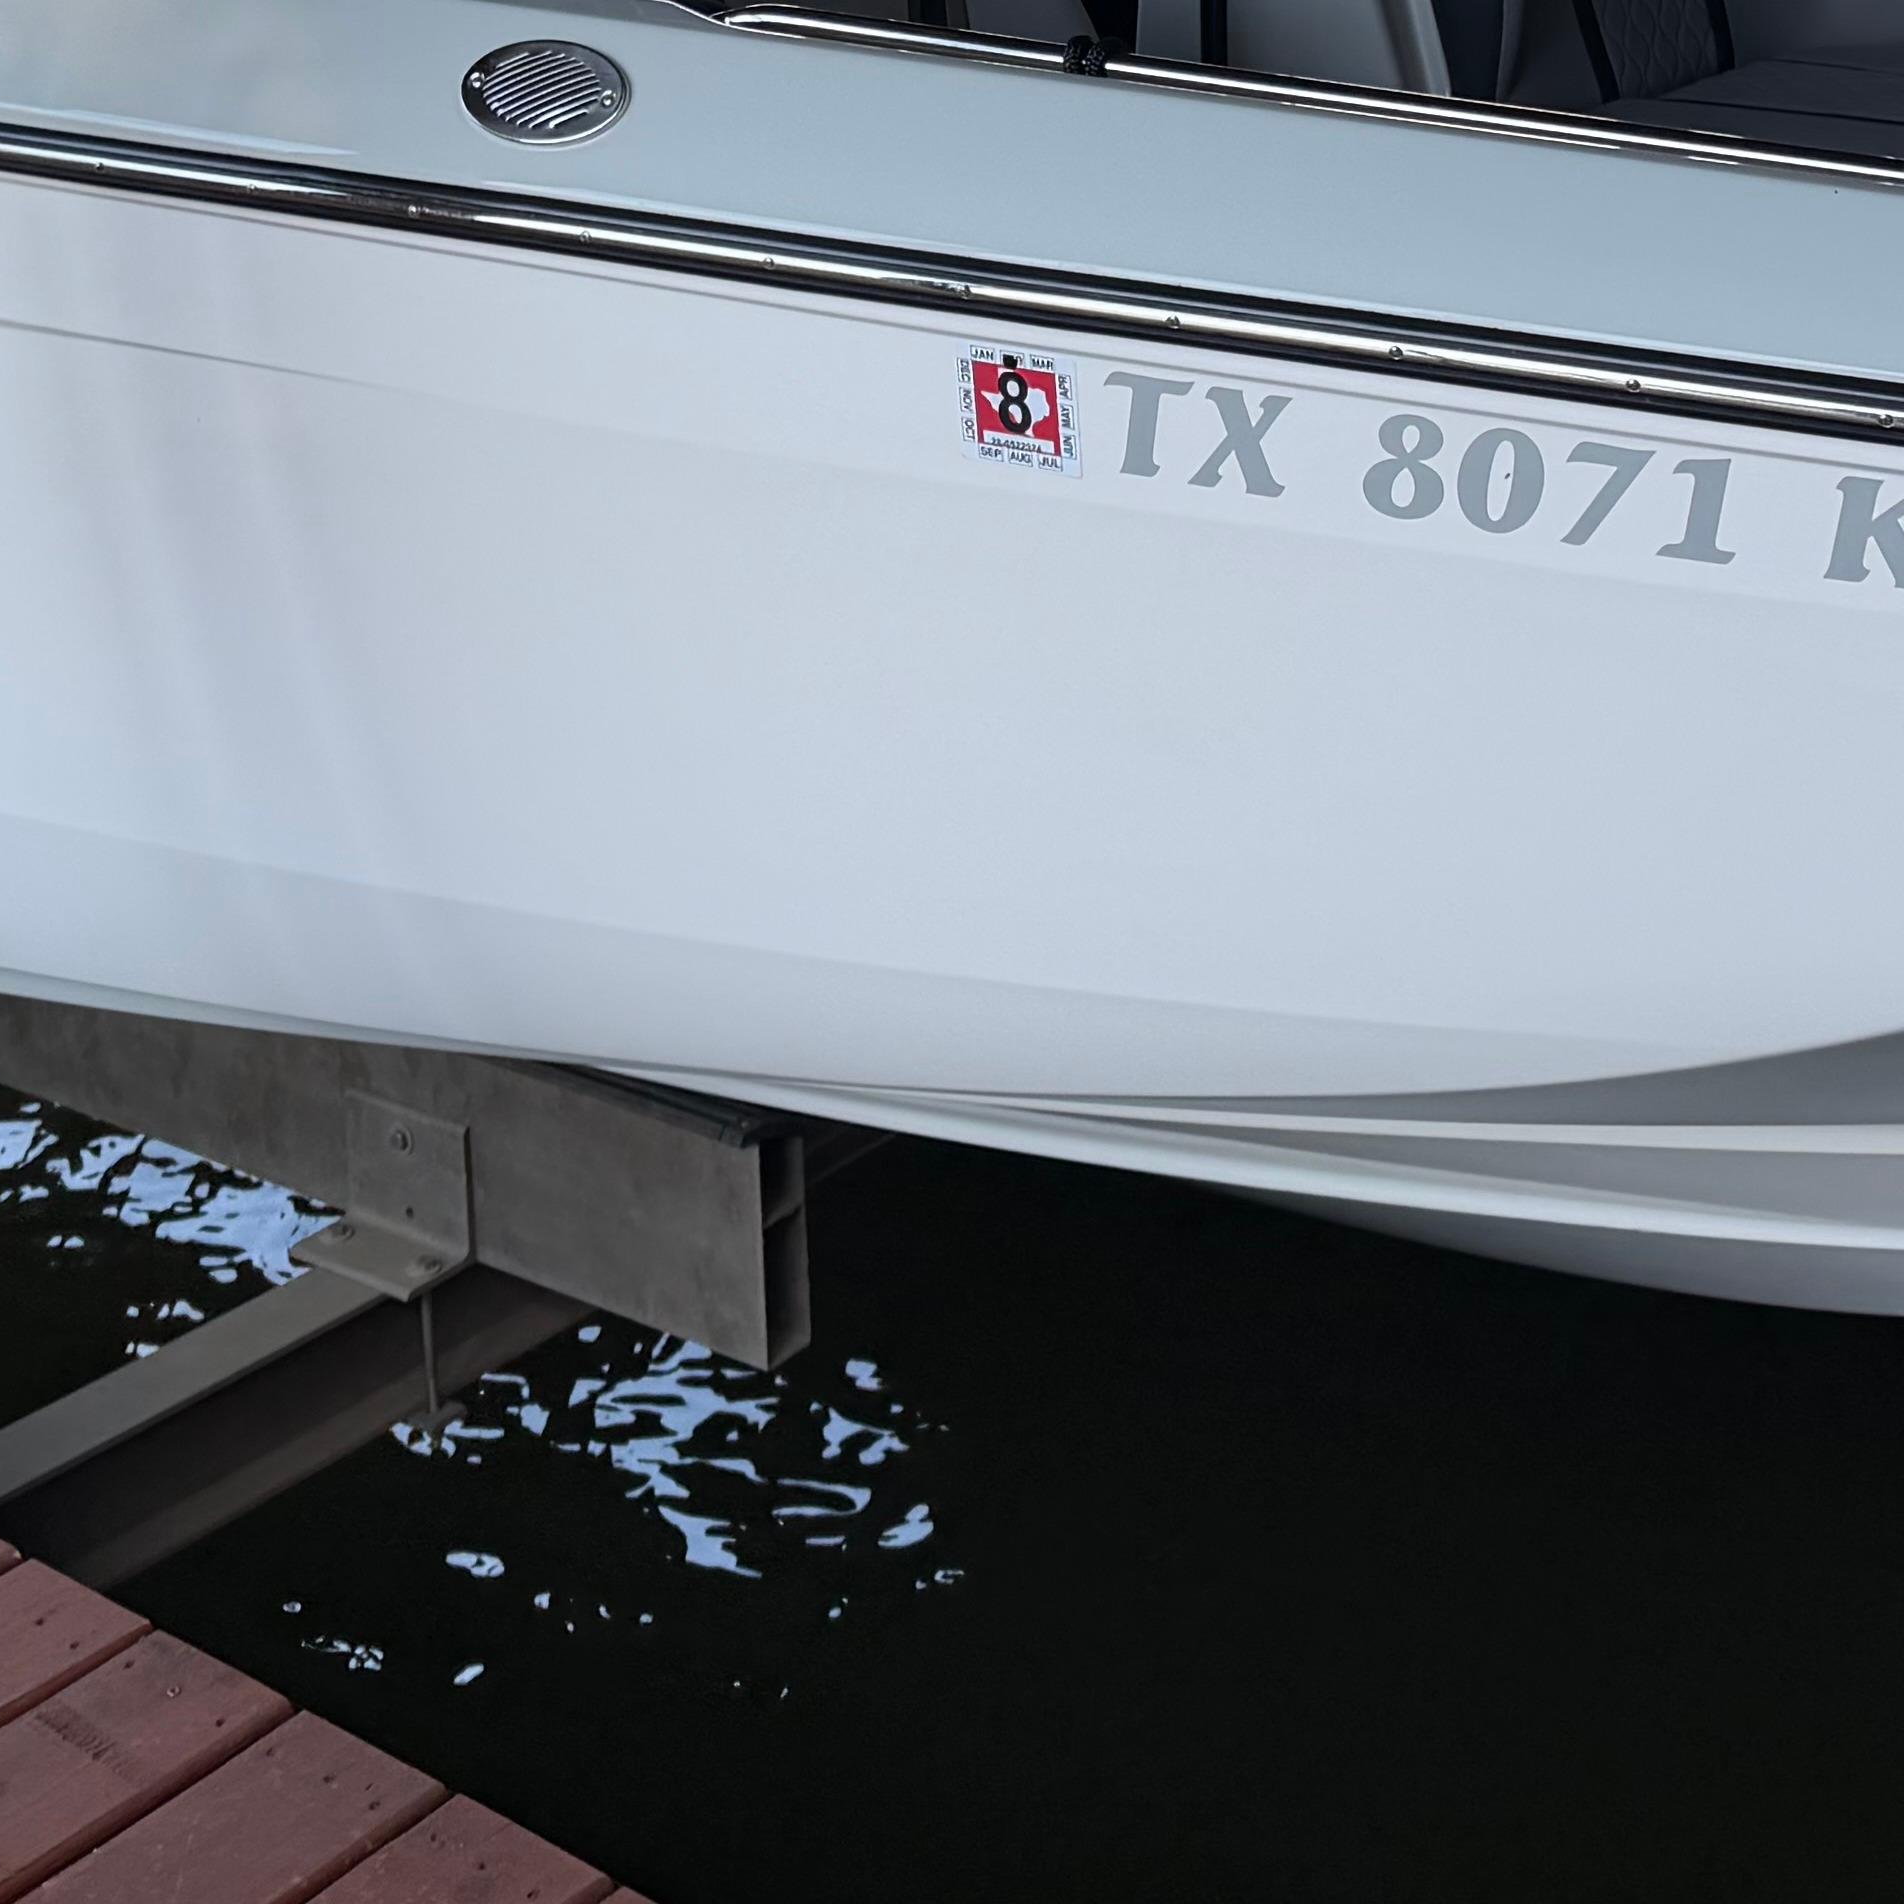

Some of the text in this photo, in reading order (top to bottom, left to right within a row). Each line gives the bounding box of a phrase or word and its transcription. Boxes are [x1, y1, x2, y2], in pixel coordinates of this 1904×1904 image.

[972, 348, 994, 361] JAN
[1058, 375, 1069, 399] APR
[998, 371, 1032, 435] 8
[1061, 405, 1072, 428] MAY
[965, 419, 976, 440] OCT
[980, 446, 1002, 458] SEP
[1010, 452, 1031, 464] AUG
[1038, 457, 1061, 469] JUL
[1103, 372, 1294, 498] TX
[1362, 414, 1737, 565] 8071
